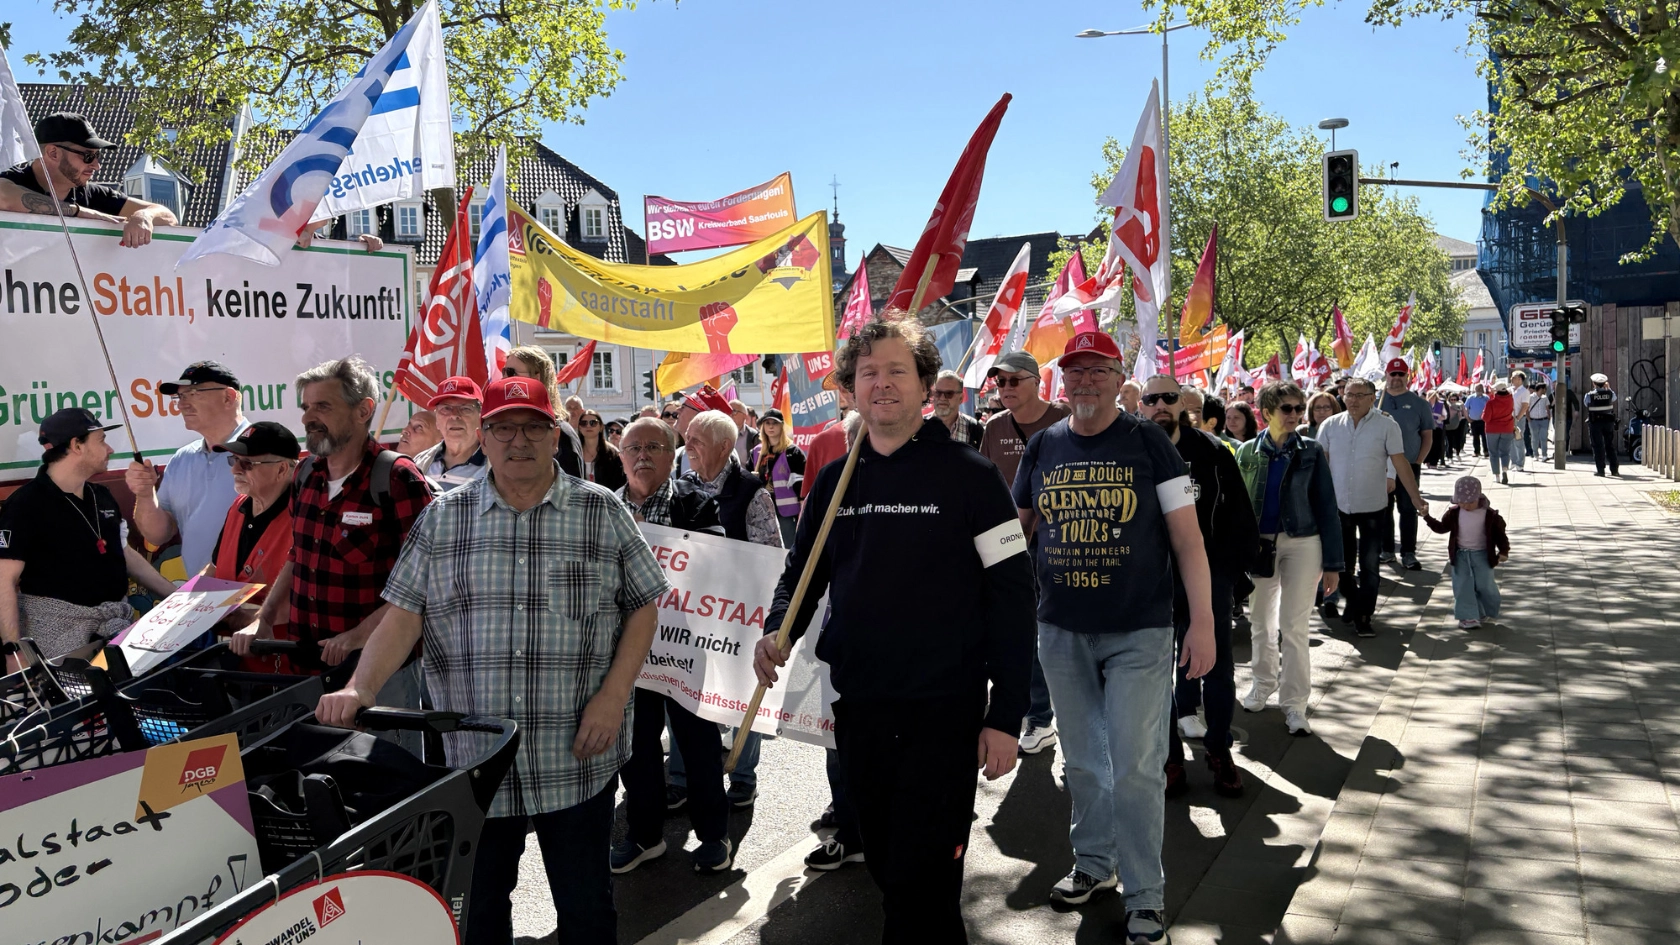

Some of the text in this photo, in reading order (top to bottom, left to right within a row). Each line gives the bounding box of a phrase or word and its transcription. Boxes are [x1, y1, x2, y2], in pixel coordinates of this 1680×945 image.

[647, 204, 662, 215] Wir
[722, 184, 784, 207] Forderungen!
[647, 209, 789, 241] BSW Kreisverband Saarlouis
[0, 269, 402, 324] hne Stahl, keine Zukunft!
[581, 291, 675, 321] saarstahl
[1520, 308, 1553, 320] GE
[1520, 320, 1552, 328] Gerüs
[807, 354, 831, 374] UNS
[130, 378, 181, 418] Sta
[240, 383, 287, 411] nur
[1042, 467, 1071, 486] WILD
[1089, 467, 1133, 483] ROUGH
[874, 503, 918, 514] machen
[920, 504, 940, 514] wir.
[1038, 487, 1138, 525] GLENWOOD
[1058, 508, 1116, 522] ADVENTURE
[1060, 519, 1109, 543] TOURS
[651, 545, 690, 572] EG
[1044, 546, 1131, 556] MOUNTAIN PIONEERS
[1047, 556, 1122, 567] ALWAYS ON THE TRAIL
[1064, 571, 1099, 588] 1956
[660, 625, 741, 657] WIR nicht
[680, 681, 771, 719] Geschäftssteen
[774, 711, 796, 724] der
[799, 713, 813, 726] IG
[184, 766, 216, 783] DGB
[295, 925, 317, 945] UNS
